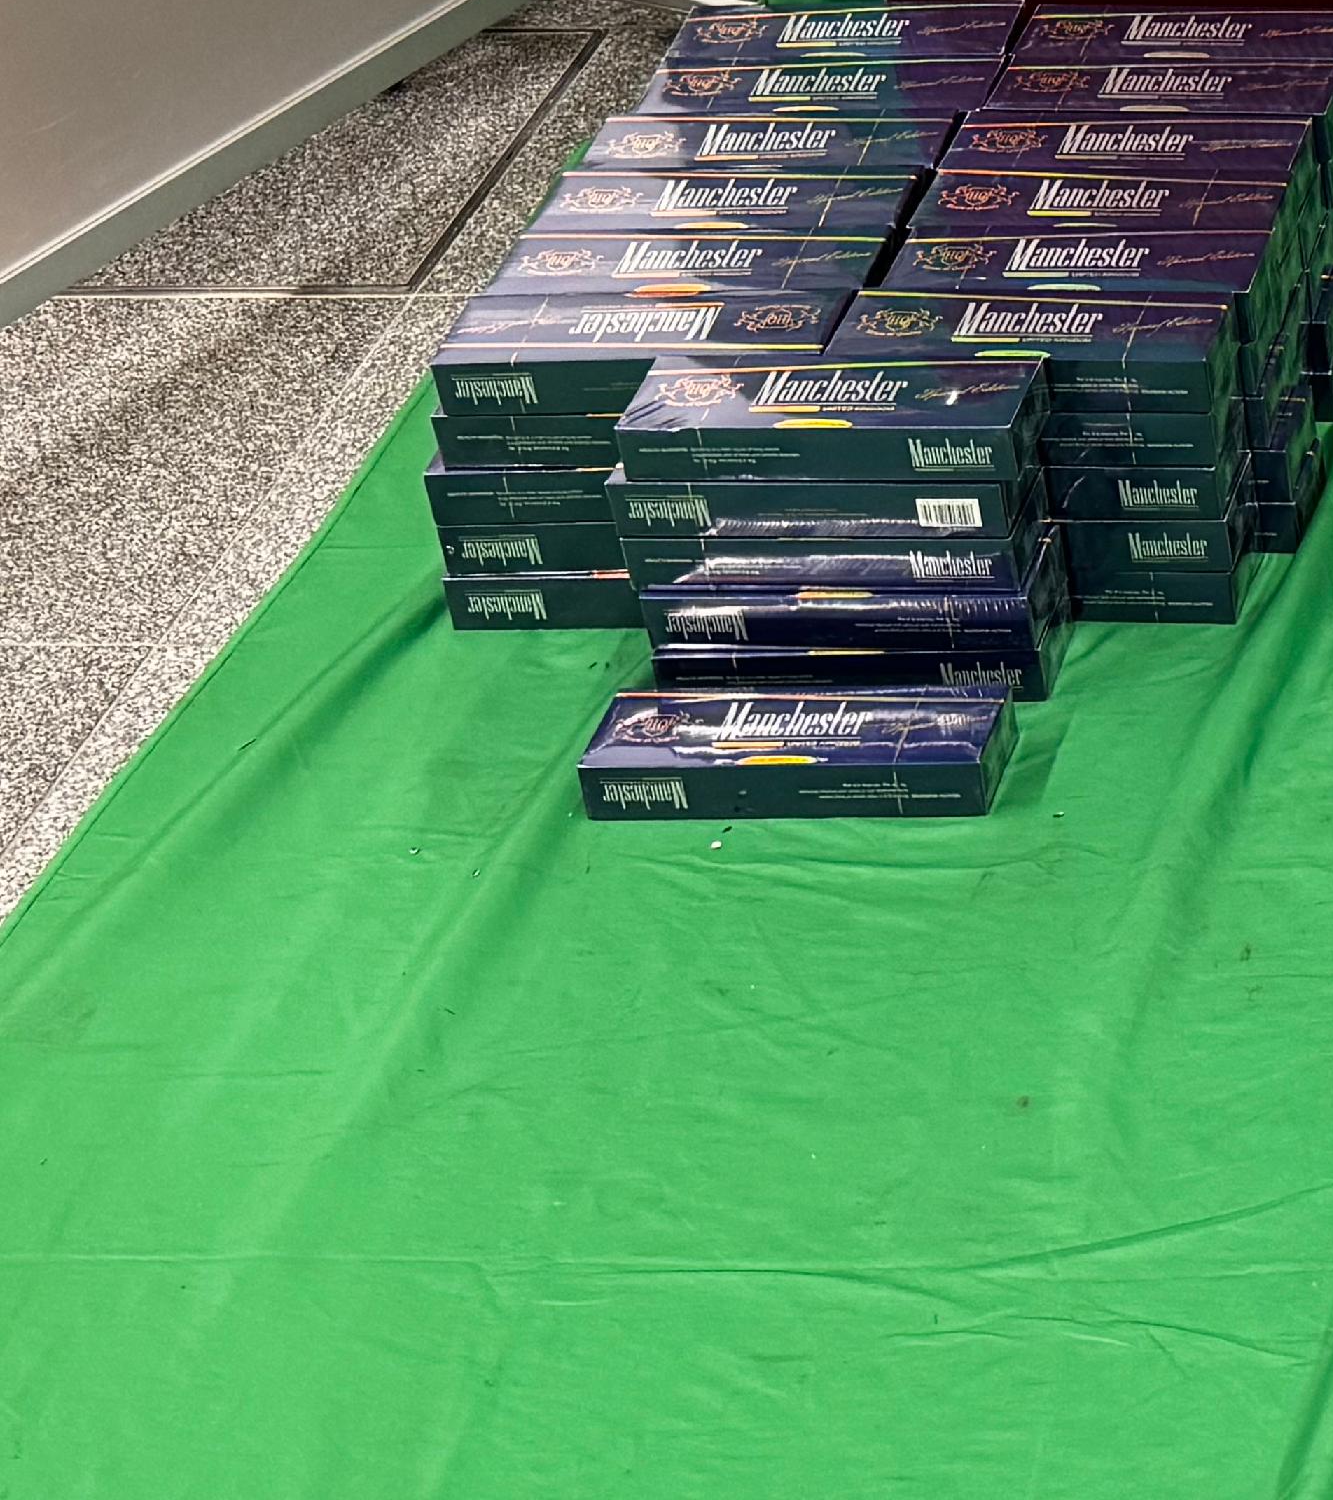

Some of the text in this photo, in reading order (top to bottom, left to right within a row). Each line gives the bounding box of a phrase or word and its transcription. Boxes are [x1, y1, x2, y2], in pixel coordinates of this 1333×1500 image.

[778, 13, 910, 43] Manchester
[1124, 15, 1252, 40] Manchester
[750, 67, 887, 96] Manchester
[1100, 66, 1232, 93] Manchester
[697, 121, 837, 156] Manchester
[1057, 124, 1194, 153] Manchester
[654, 179, 798, 211] Manchester
[1029, 179, 1170, 210] Manchester
[614, 240, 763, 273] Manchester
[1006, 238, 1150, 270] Manchester
[570, 305, 725, 342] Manchester
[953, 302, 1103, 336] Manchester
[752, 370, 908, 405] Manchester
[908, 438, 994, 468] Manchester
[1118, 480, 1198, 507] Manchester
[1128, 533, 1208, 561] Manchester
[909, 551, 993, 579] Manchester
[717, 701, 873, 740] Manchester
